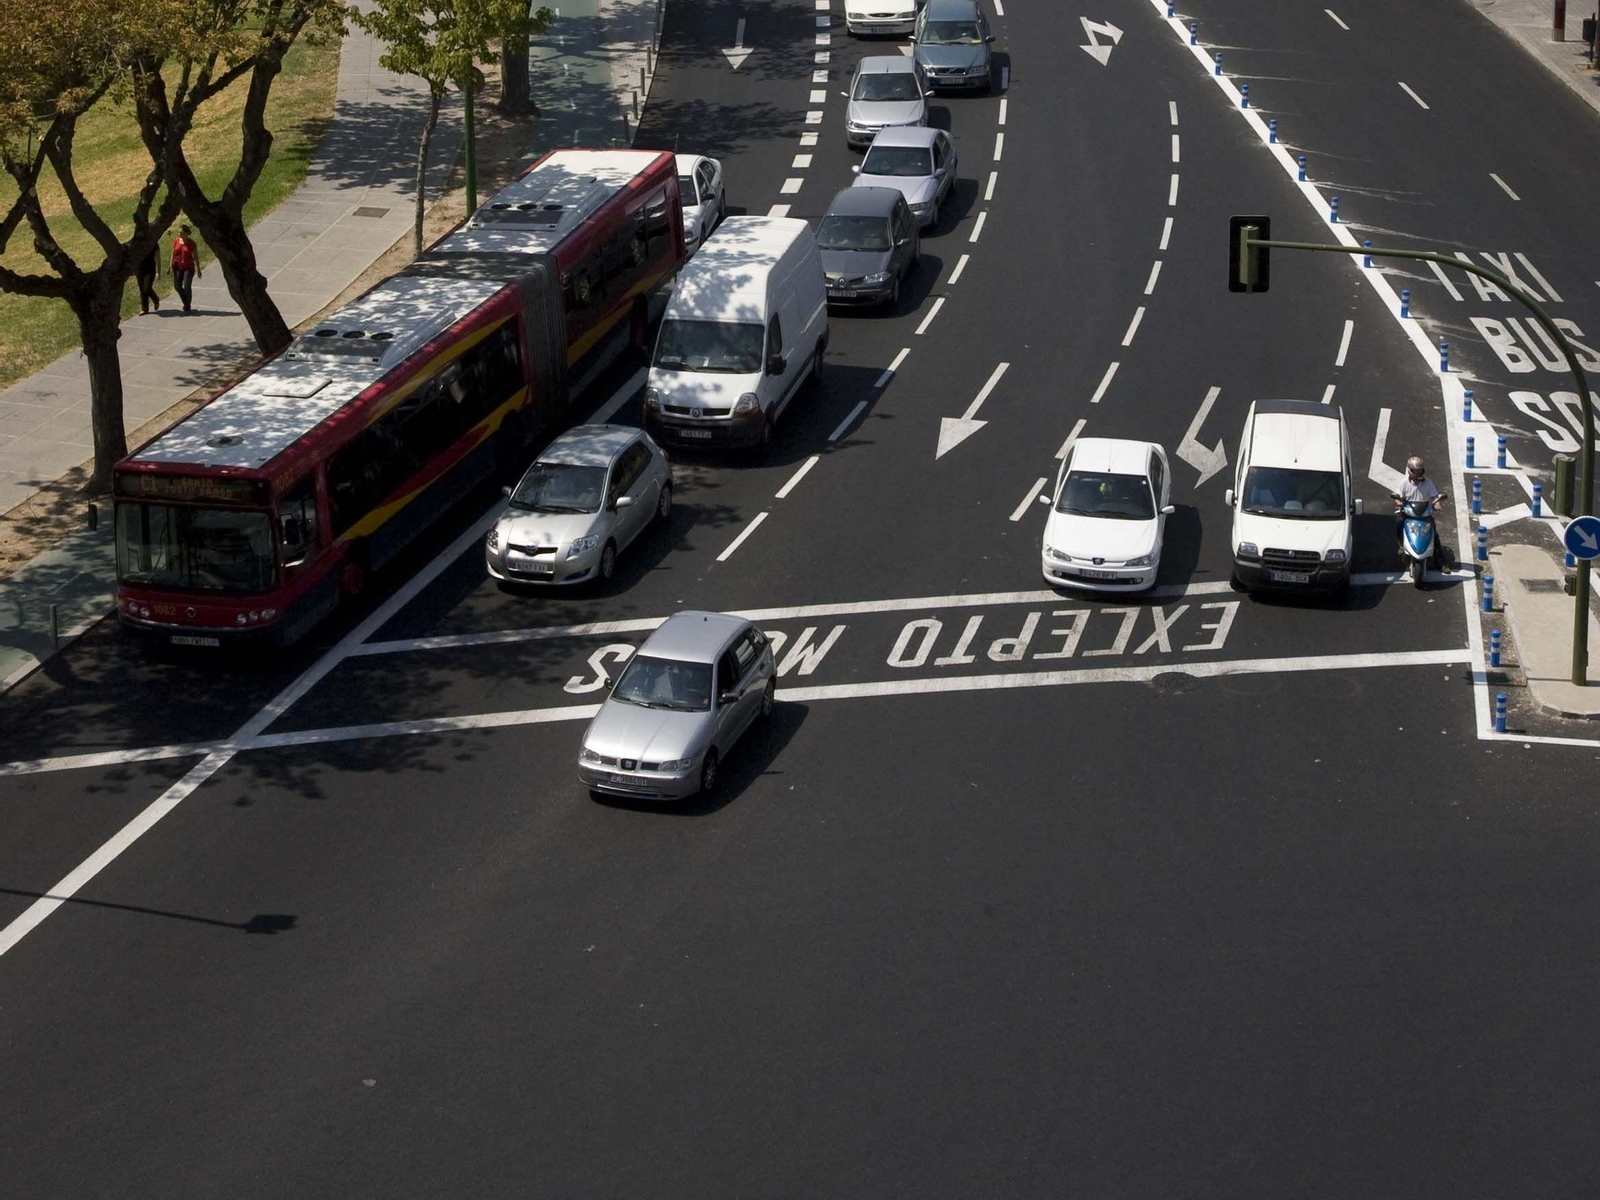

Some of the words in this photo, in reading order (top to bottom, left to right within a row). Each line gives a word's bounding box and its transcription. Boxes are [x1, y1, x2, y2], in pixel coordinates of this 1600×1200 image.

[1415, 252, 1564, 303] TAXI
[1469, 316, 1600, 374] BUS
[153, 604, 176, 616] 1082
[887, 601, 1240, 668] EXCEPTO
